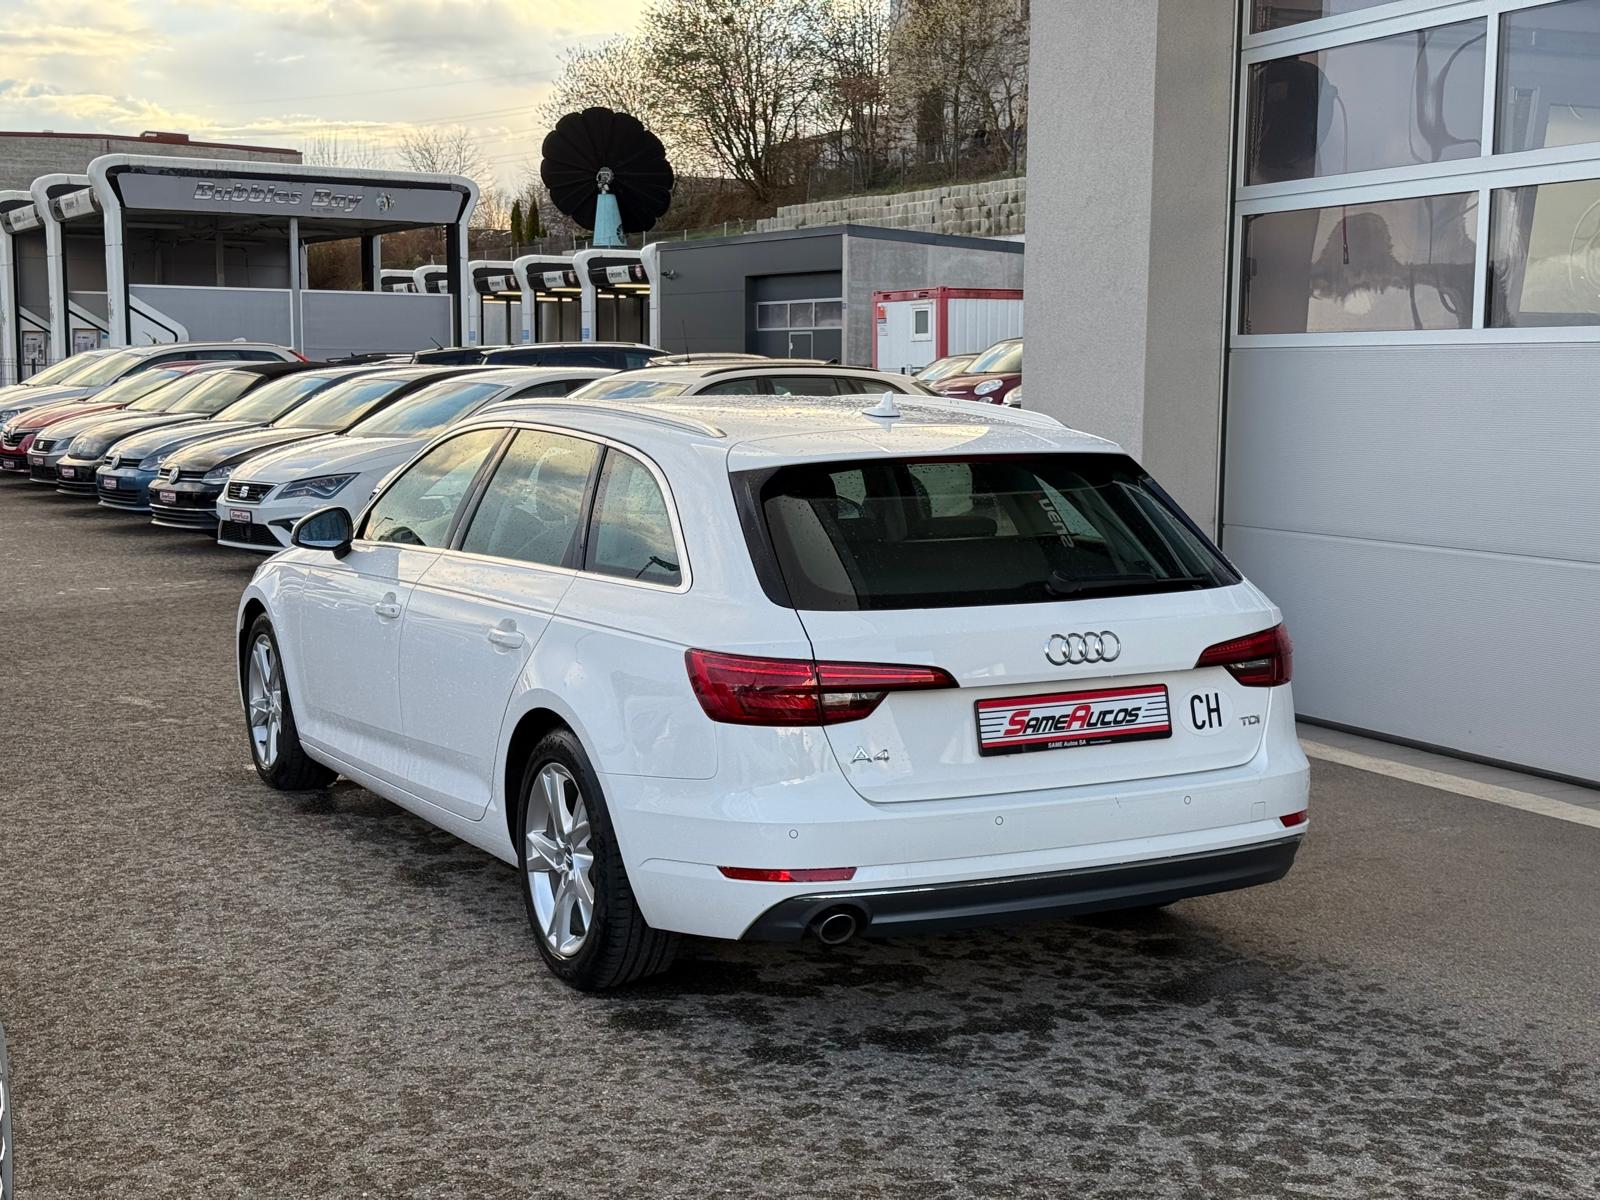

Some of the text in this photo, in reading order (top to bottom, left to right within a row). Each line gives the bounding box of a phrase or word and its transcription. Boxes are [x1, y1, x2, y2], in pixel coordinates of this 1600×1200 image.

[194, 181, 364, 212] Bubbles Bay
[1190, 692, 1222, 730] CH
[1239, 714, 1260, 726] TDI
[850, 745, 890, 764] A4
